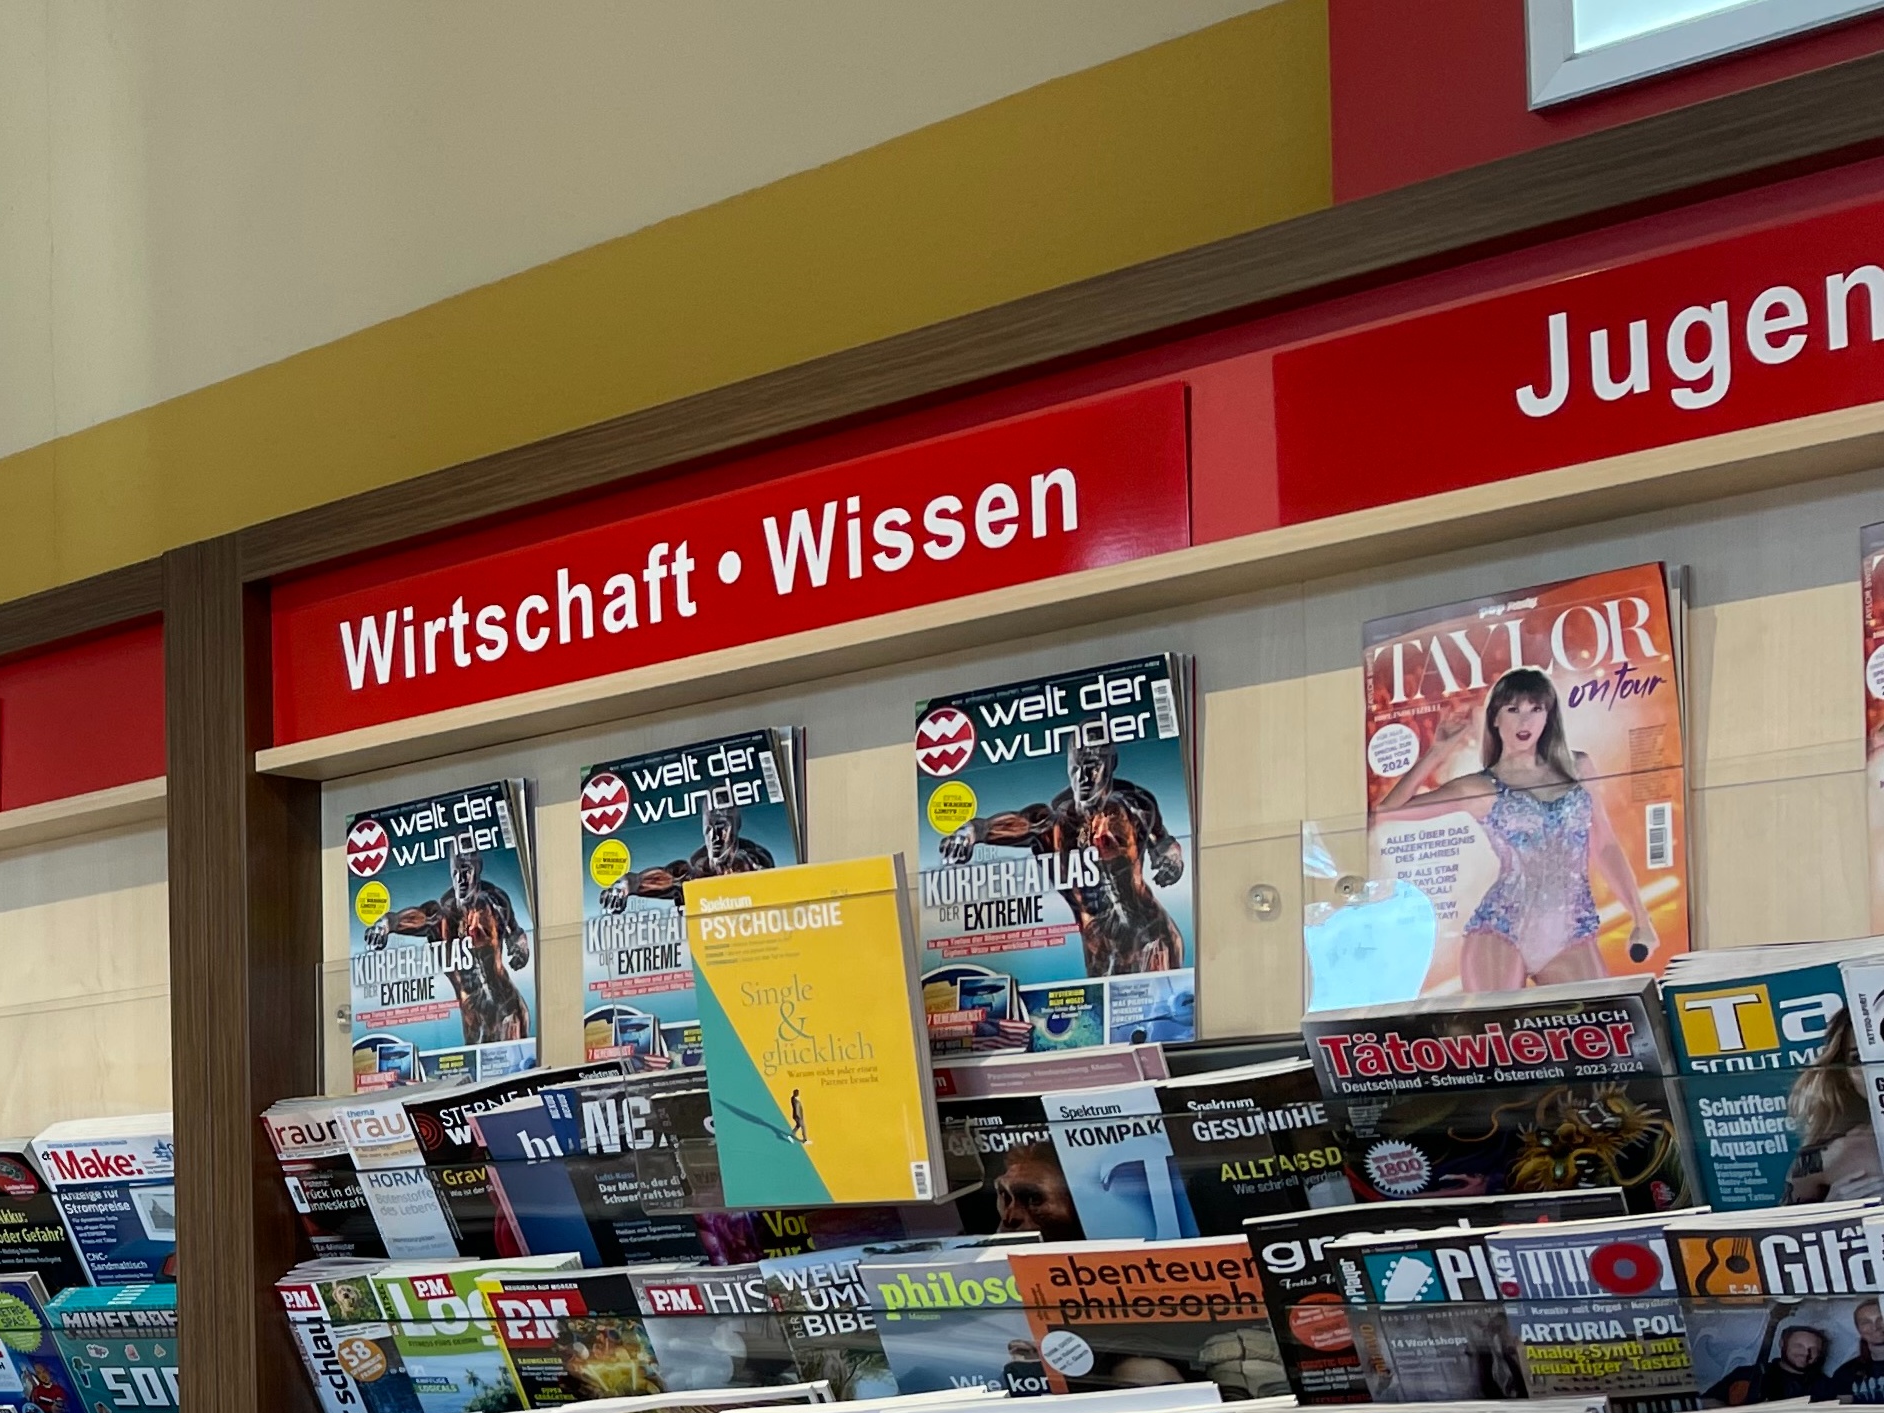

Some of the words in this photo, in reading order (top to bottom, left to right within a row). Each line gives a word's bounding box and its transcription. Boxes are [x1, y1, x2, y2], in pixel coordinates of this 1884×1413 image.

[340, 540, 697, 690] Wirtschaft
[763, 466, 1078, 595] Wissen
[1374, 596, 1662, 704] TAYLOR
[978, 686, 1068, 729] welt
[1079, 672, 1147, 715] der
[1611, 663, 1667, 711] tour
[980, 711, 1151, 764] wunder
[632, 751, 698, 793] welt
[706, 745, 756, 783] der
[1382, 758, 1410, 773] 2024
[390, 802, 447, 838] welt
[453, 793, 493, 829] der
[634, 777, 763, 825] wunder
[392, 822, 499, 868] wunder
[1386, 833, 1415, 846] ALLES
[1418, 828, 1443, 843] ÜBER
[1447, 826, 1470, 838] DAS
[924, 845, 1100, 909] KÖRPER-ATLAS
[699, 894, 752, 914] Spektrum
[963, 895, 1043, 931] EXTREME
[700, 902, 842, 942] PSYCHOLOGIE
[353, 936, 474, 986] KÖRPER-ATLAS
[380, 976, 436, 1006] EXTREME
[740, 974, 813, 1010] Single
[777, 1007, 812, 1043] &
[1513, 1008, 1629, 1030] JAHRBUCH
[762, 1032, 875, 1077] glücklich
[1317, 1019, 1635, 1079] Tätowierer
[1342, 1076, 1420, 1094] Deutschland
[1432, 1070, 1484, 1088] Schweiz
[1494, 1065, 1564, 1083] Österreich
[1576, 1060, 1644, 1076] 2023-2024
[1059, 1102, 1121, 1119] Spektrum
[1699, 1094, 1787, 1116] Schriften
[1703, 1115, 1796, 1137] Raubtiere
[1710, 1134, 1788, 1159] Aquarell
[50, 1150, 144, 1179] Make:
[65, 1200, 131, 1215] Strompreise
[22, 1227, 65, 1242] Gefahr?
[1050, 1255, 1258, 1289] abenteuer
[1520, 1317, 1626, 1343] ARTURIA
[1527, 1341, 1643, 1361] Analog-Synth
[1529, 1358, 1626, 1377] neuartiger
